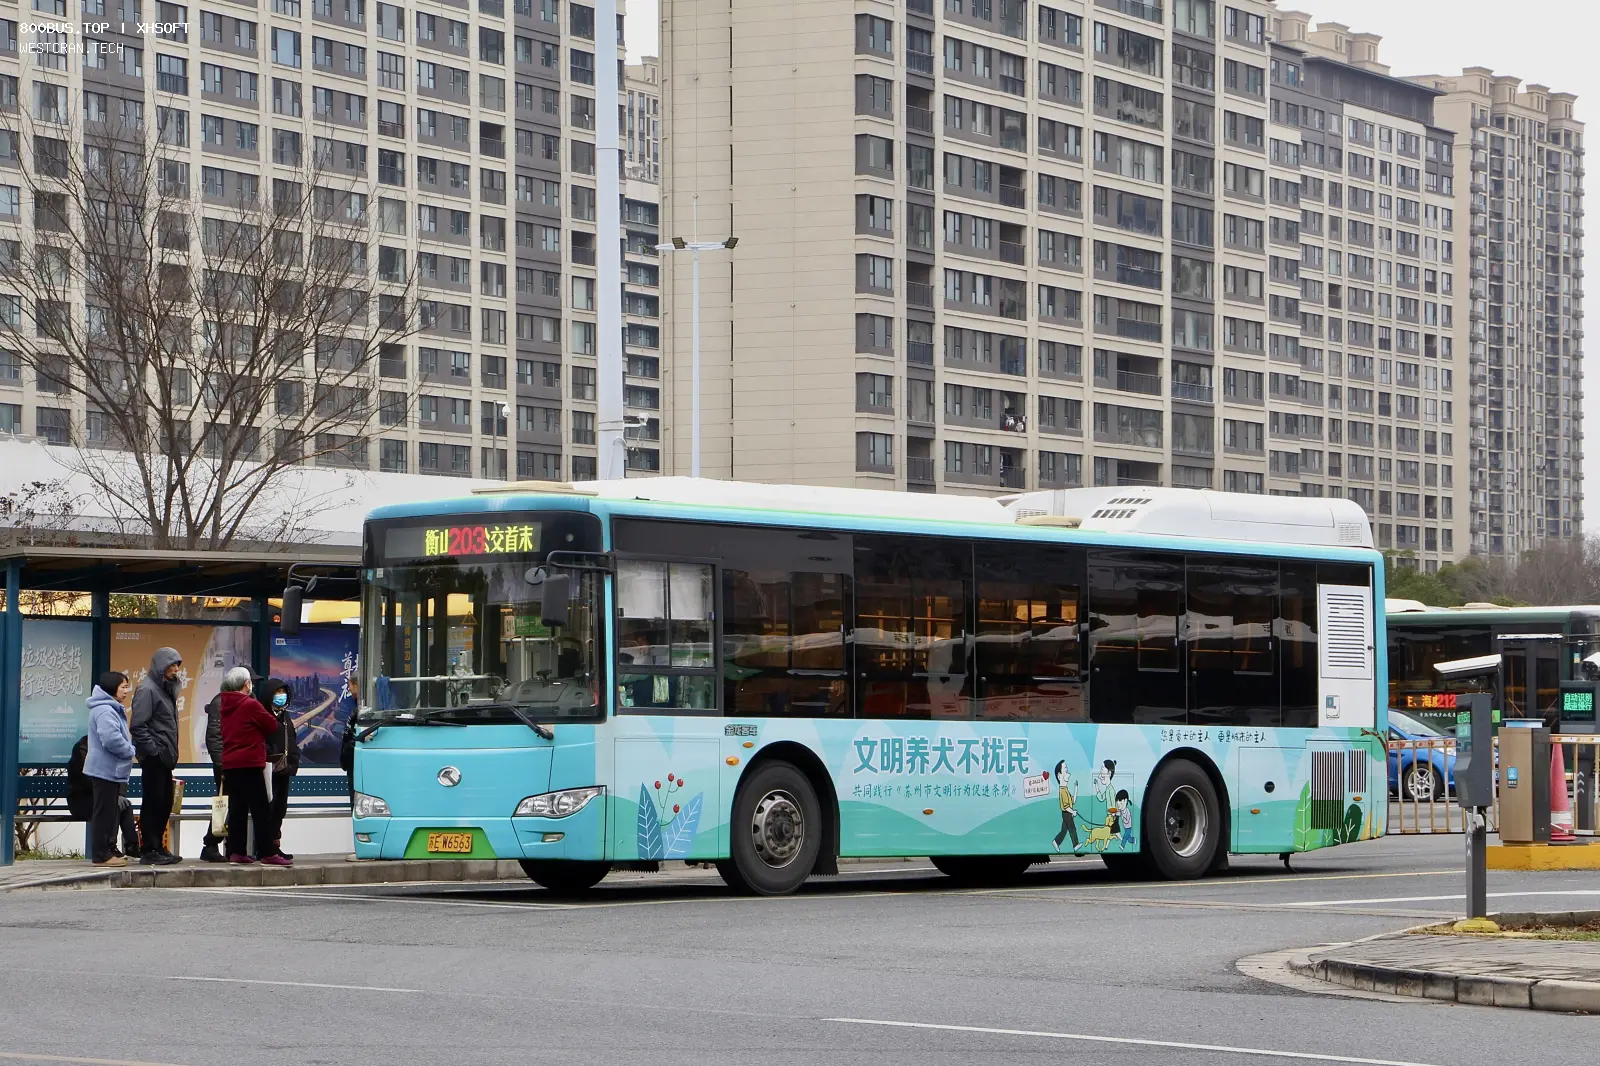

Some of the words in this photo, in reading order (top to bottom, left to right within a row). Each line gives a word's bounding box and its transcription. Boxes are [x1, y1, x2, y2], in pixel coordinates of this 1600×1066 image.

[853, 736, 1029, 775] 文明养犬不扰民
[852, 783, 1017, 799] 共同践行《苏州市文明行为促进条例》
